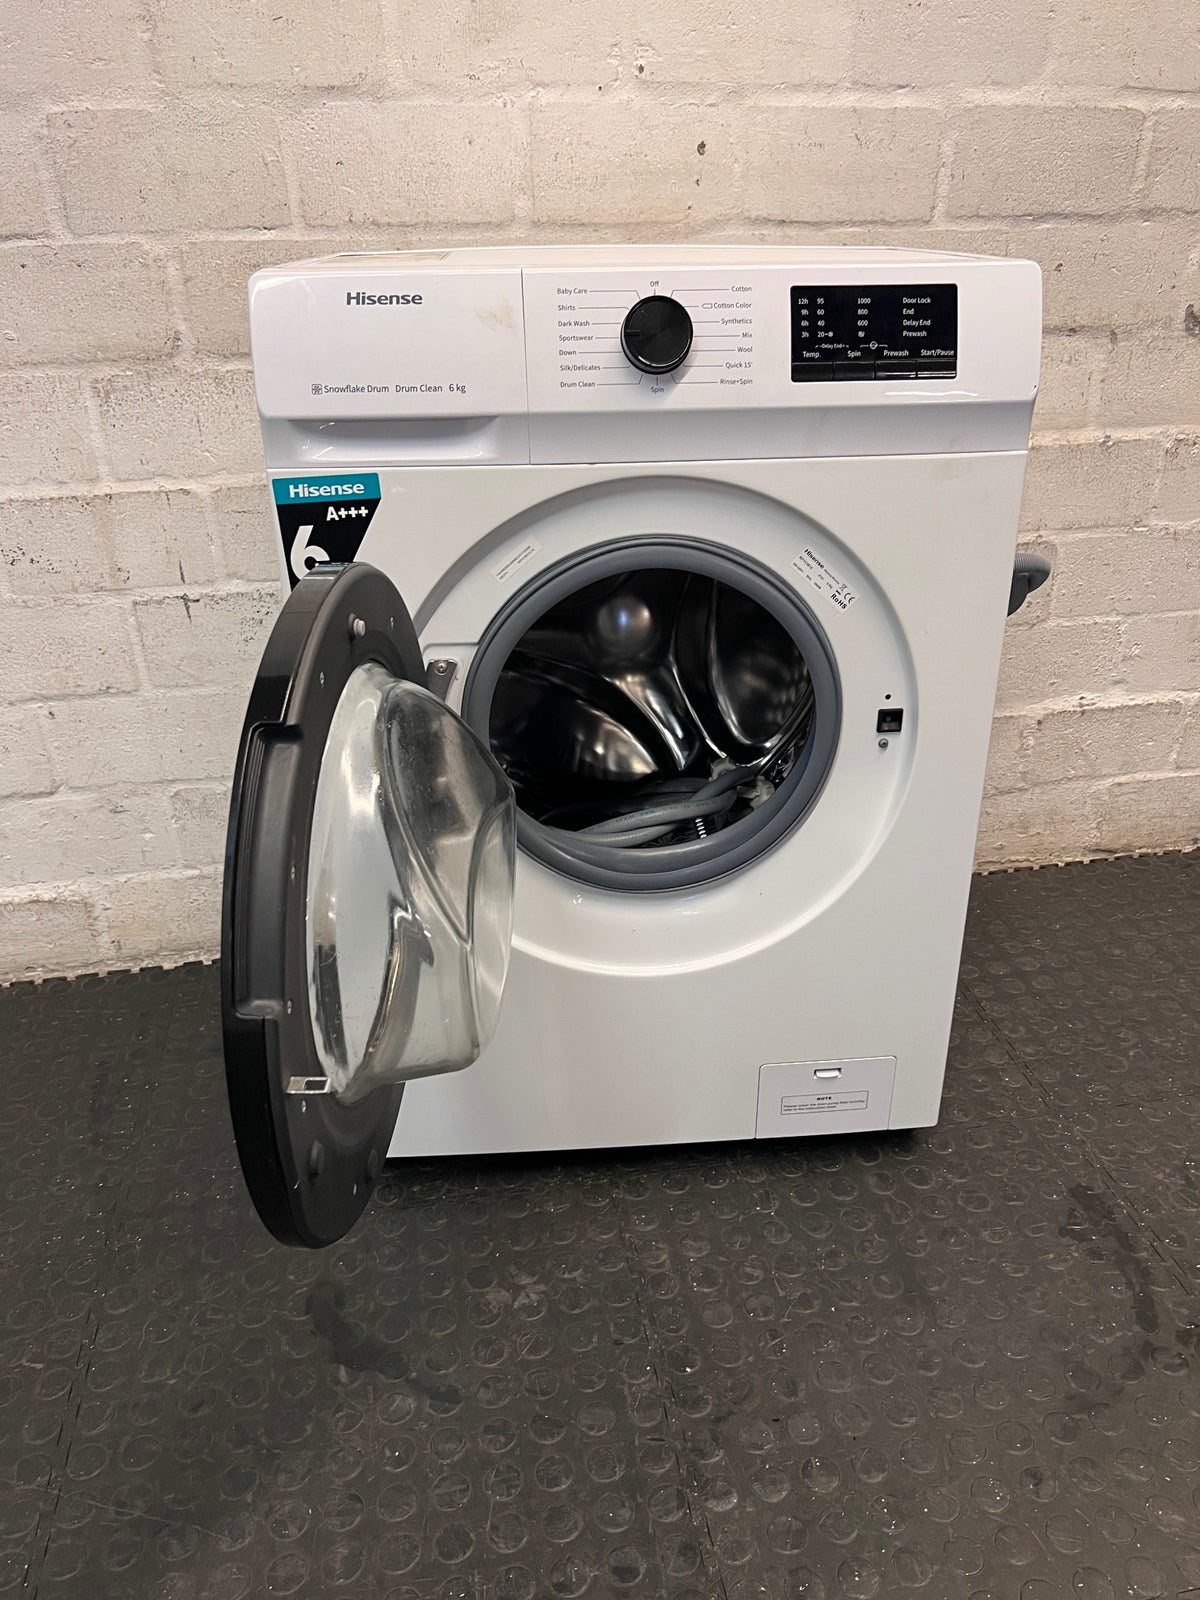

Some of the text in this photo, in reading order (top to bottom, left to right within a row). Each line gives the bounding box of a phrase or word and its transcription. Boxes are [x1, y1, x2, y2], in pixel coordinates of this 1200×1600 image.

[556, 287, 572, 295] Baby
[346, 291, 423, 306] Hisense
[902, 319, 919, 327] Delay
[847, 350, 861, 358] Spin
[883, 349, 909, 357] Prewash
[920, 348, 955, 357] Start/Pause
[559, 364, 601, 372] Silk/Delicates
[719, 377, 754, 385] Rinse+Spin
[323, 383, 467, 394] Snowflake Drum Drum Clean 6 kg
[650, 386, 665, 394] Spin
[288, 483, 365, 499] Hisense
[326, 506, 369, 522] A+++
[290, 524, 331, 581] 6
[804, 548, 825, 569] Hisense
[830, 593, 848, 610] RoHS
